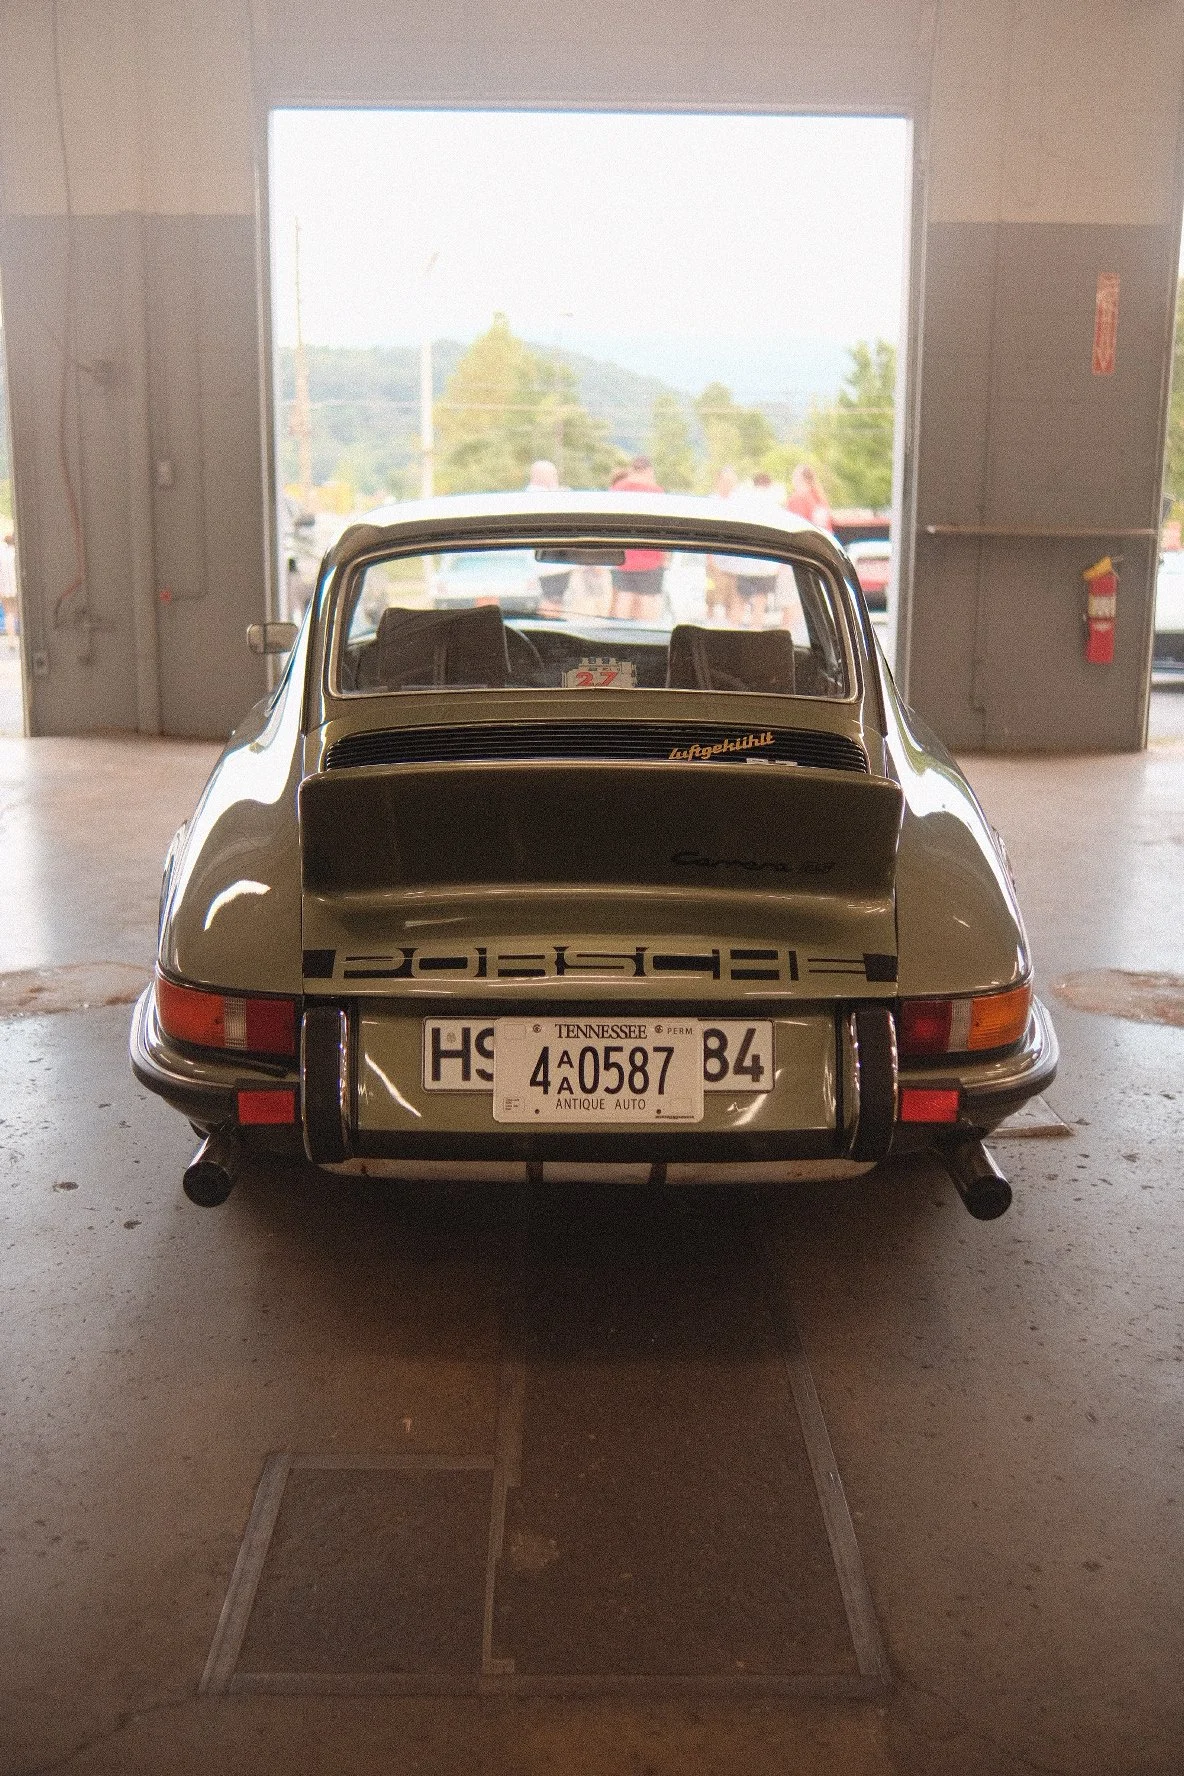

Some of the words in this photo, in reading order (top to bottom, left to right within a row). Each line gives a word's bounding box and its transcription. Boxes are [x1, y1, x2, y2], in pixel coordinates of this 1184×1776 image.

[340, 946, 866, 981] PORSCHE
[555, 1023, 648, 1040] TENNESSEE
[667, 1027, 693, 1035] PERM
[555, 1098, 605, 1110] ANTIQUE
[614, 1098, 646, 1110] AUTO
